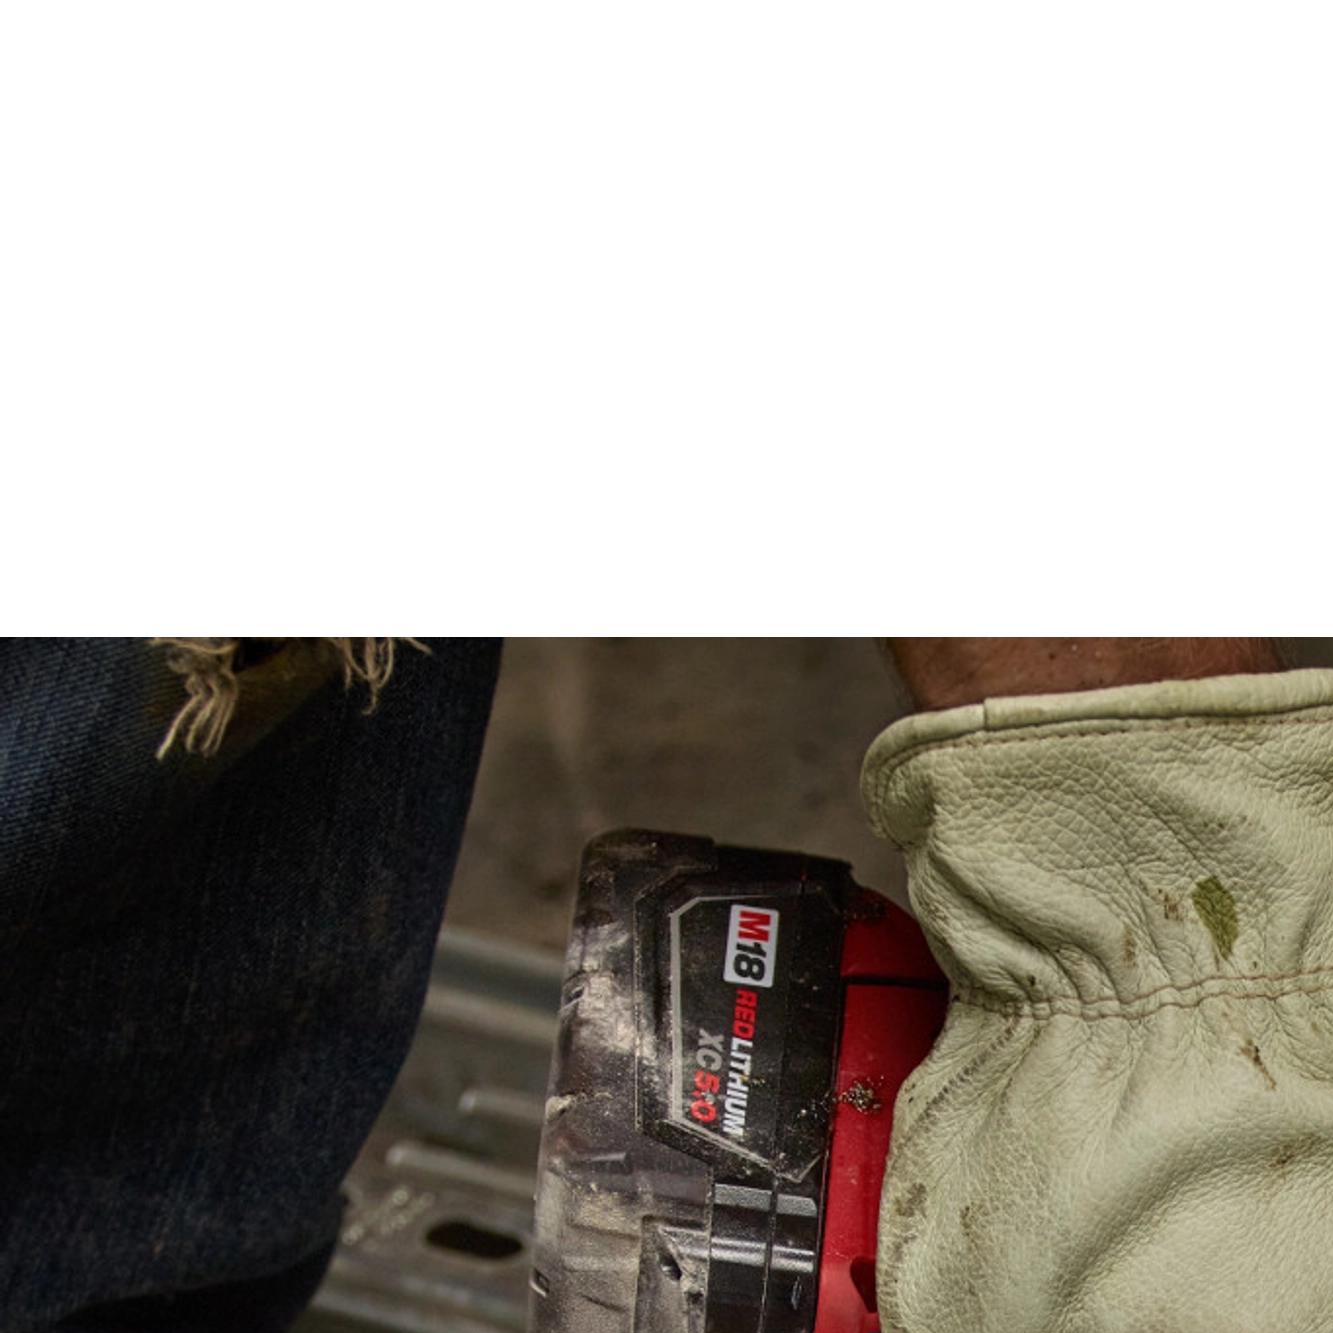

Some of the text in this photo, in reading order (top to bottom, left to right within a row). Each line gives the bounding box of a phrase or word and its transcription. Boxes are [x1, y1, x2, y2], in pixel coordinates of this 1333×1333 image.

[691, 1027, 725, 1123] XC 5.0
[722, 910, 771, 1137] M18 REDLITHIUM
